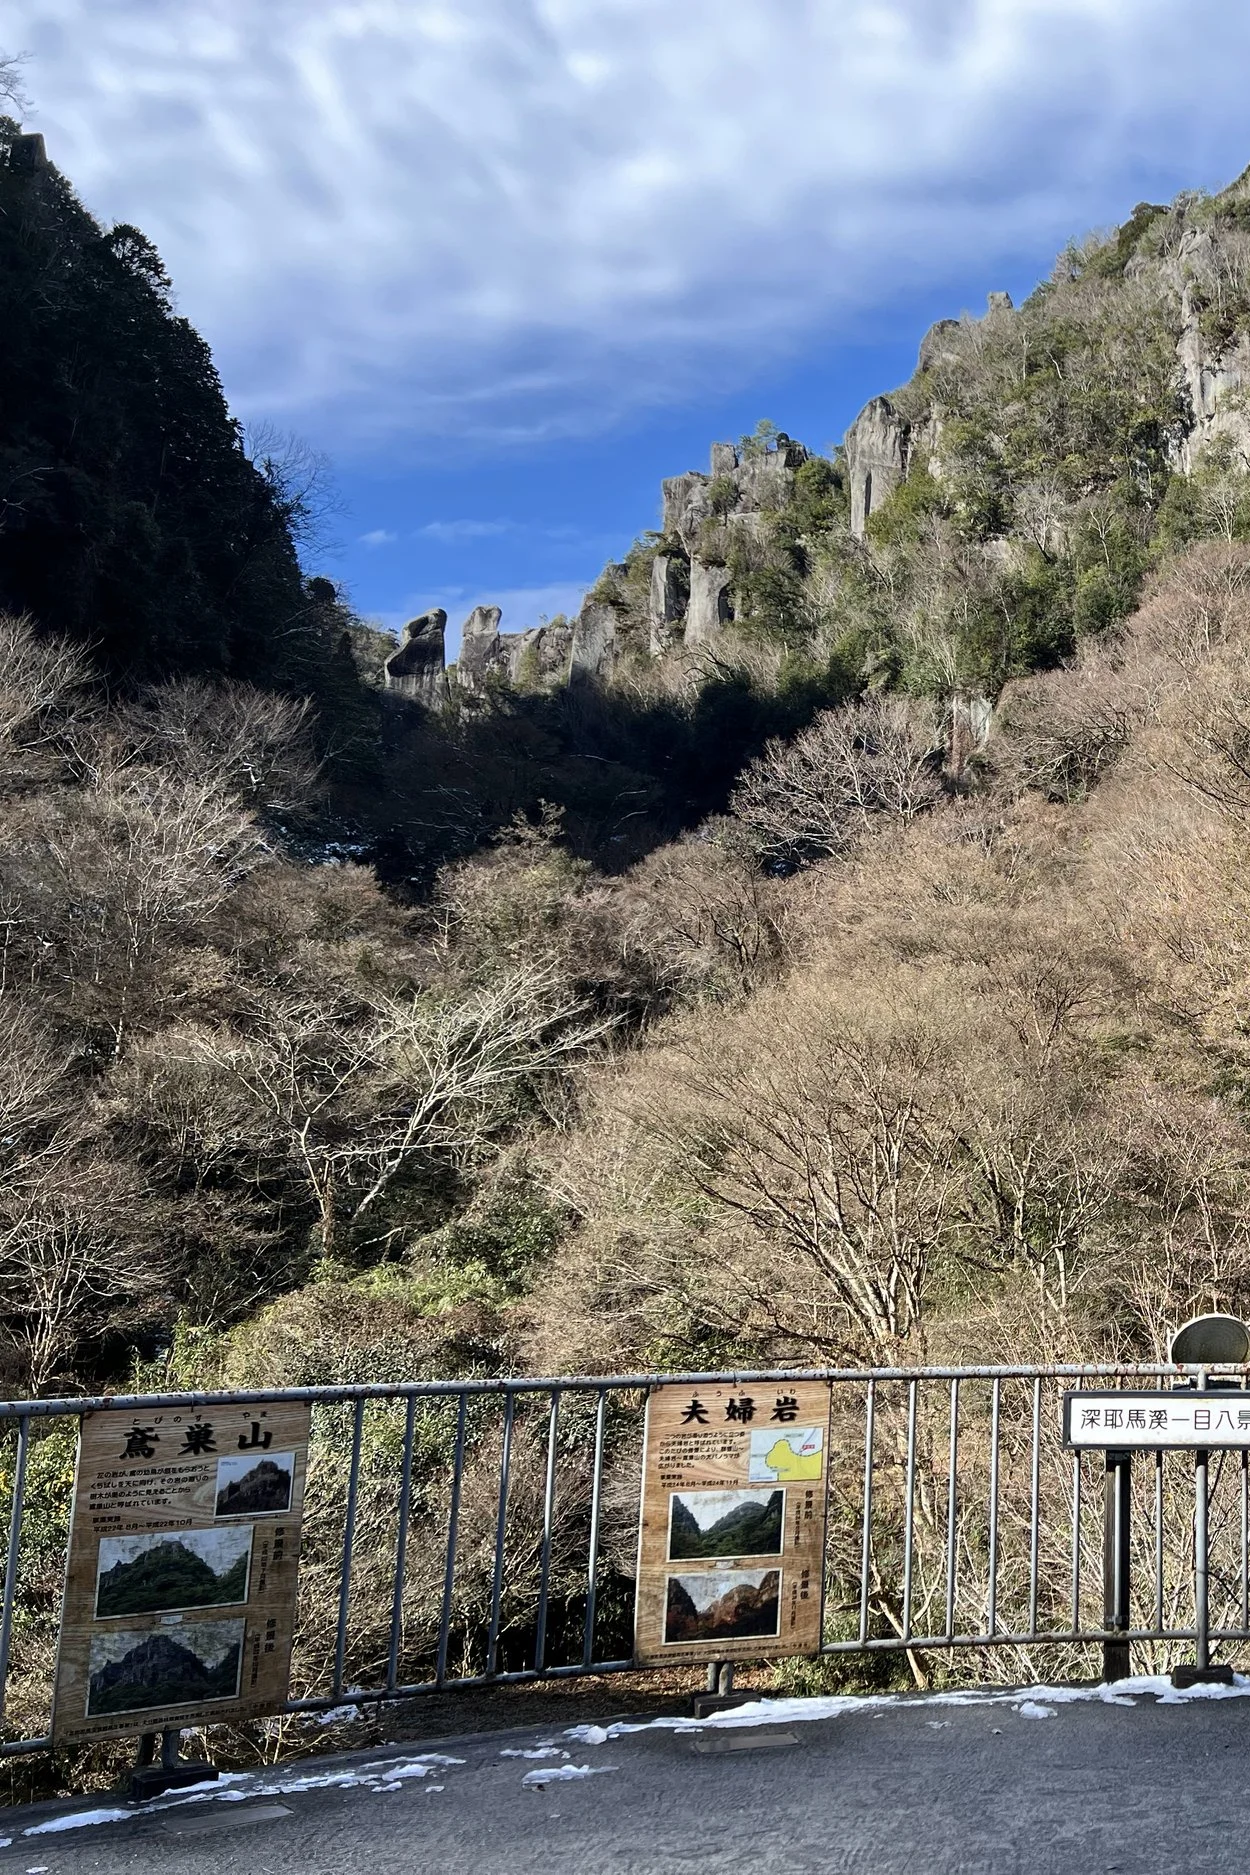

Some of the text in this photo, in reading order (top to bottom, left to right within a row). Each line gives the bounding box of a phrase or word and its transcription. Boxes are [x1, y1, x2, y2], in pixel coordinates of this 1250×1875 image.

[680, 1396, 800, 1425] 夫婦岩
[118, 1421, 274, 1459] 鳶巣山
